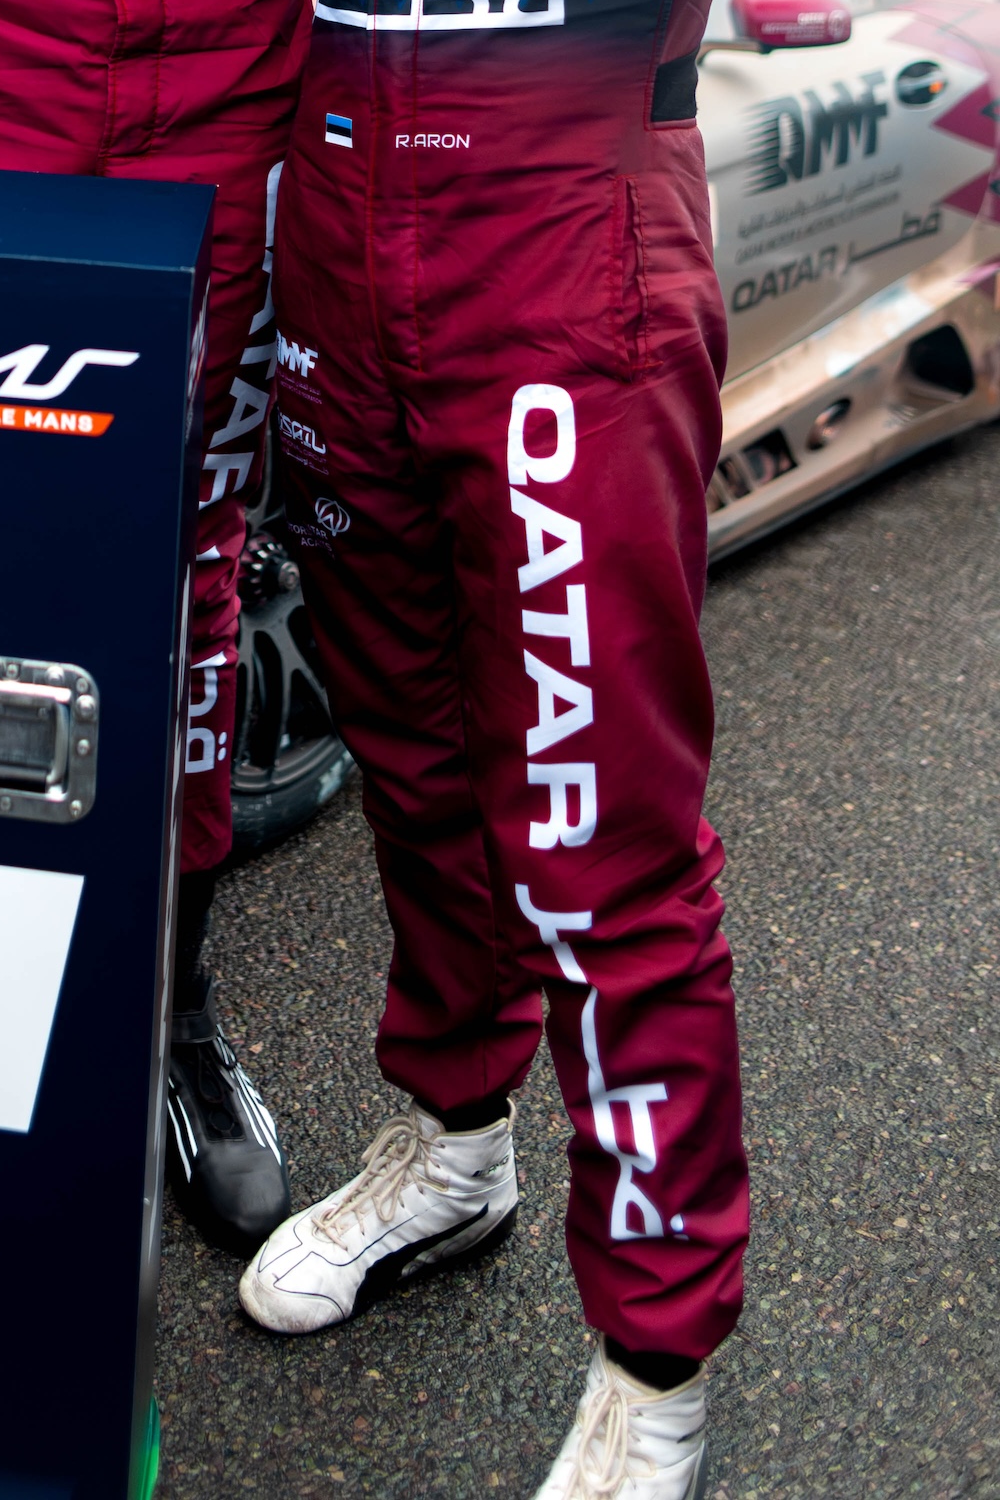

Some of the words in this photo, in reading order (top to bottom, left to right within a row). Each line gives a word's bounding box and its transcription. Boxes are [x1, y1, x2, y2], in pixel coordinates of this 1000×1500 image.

[395, 134, 470, 149] R.ARON
[732, 244, 838, 314] QATAR
[24, 409, 93, 432] MANS
[507, 383, 598, 852] QATAR
